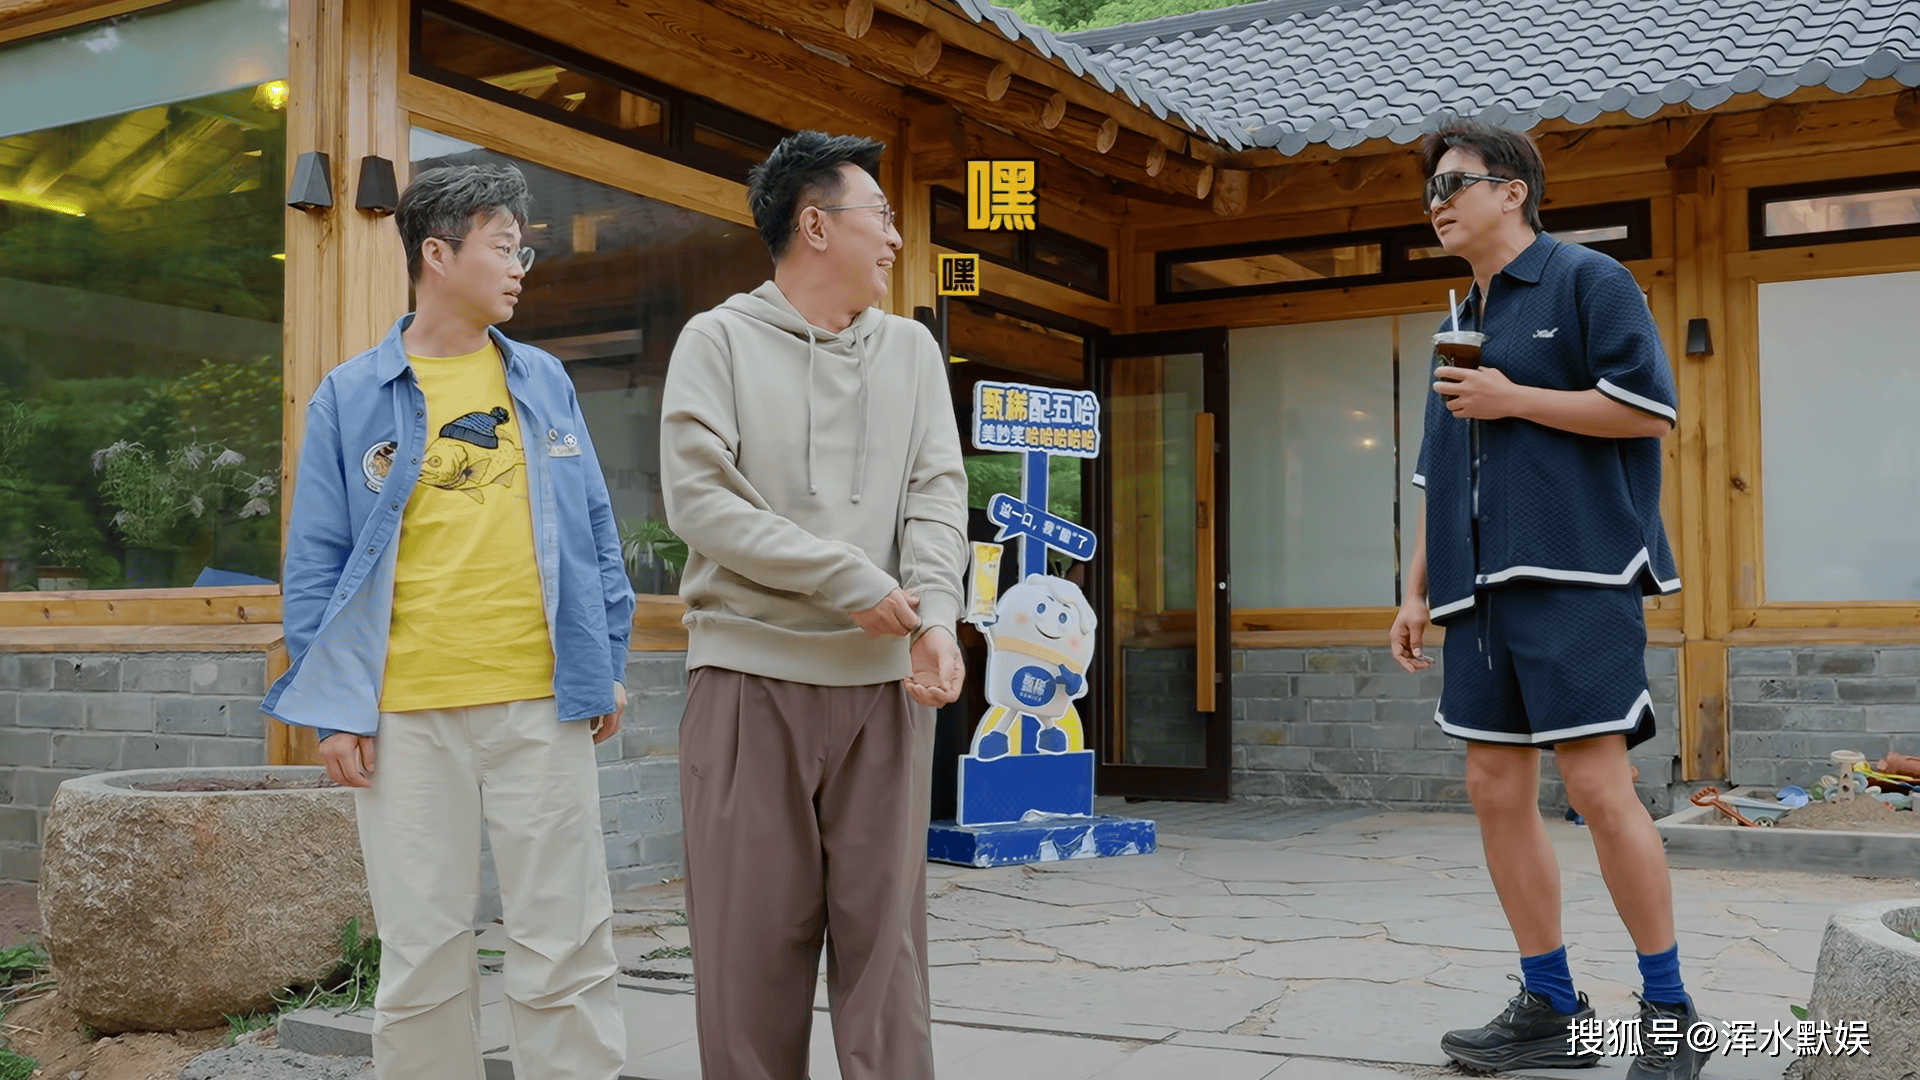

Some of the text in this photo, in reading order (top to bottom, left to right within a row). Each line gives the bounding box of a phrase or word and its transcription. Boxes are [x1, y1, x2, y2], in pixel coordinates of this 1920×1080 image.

[982, 387, 1095, 426] 甄稀配五哈
[981, 423, 1096, 451] 美妙笑哈哈哈哈哈
